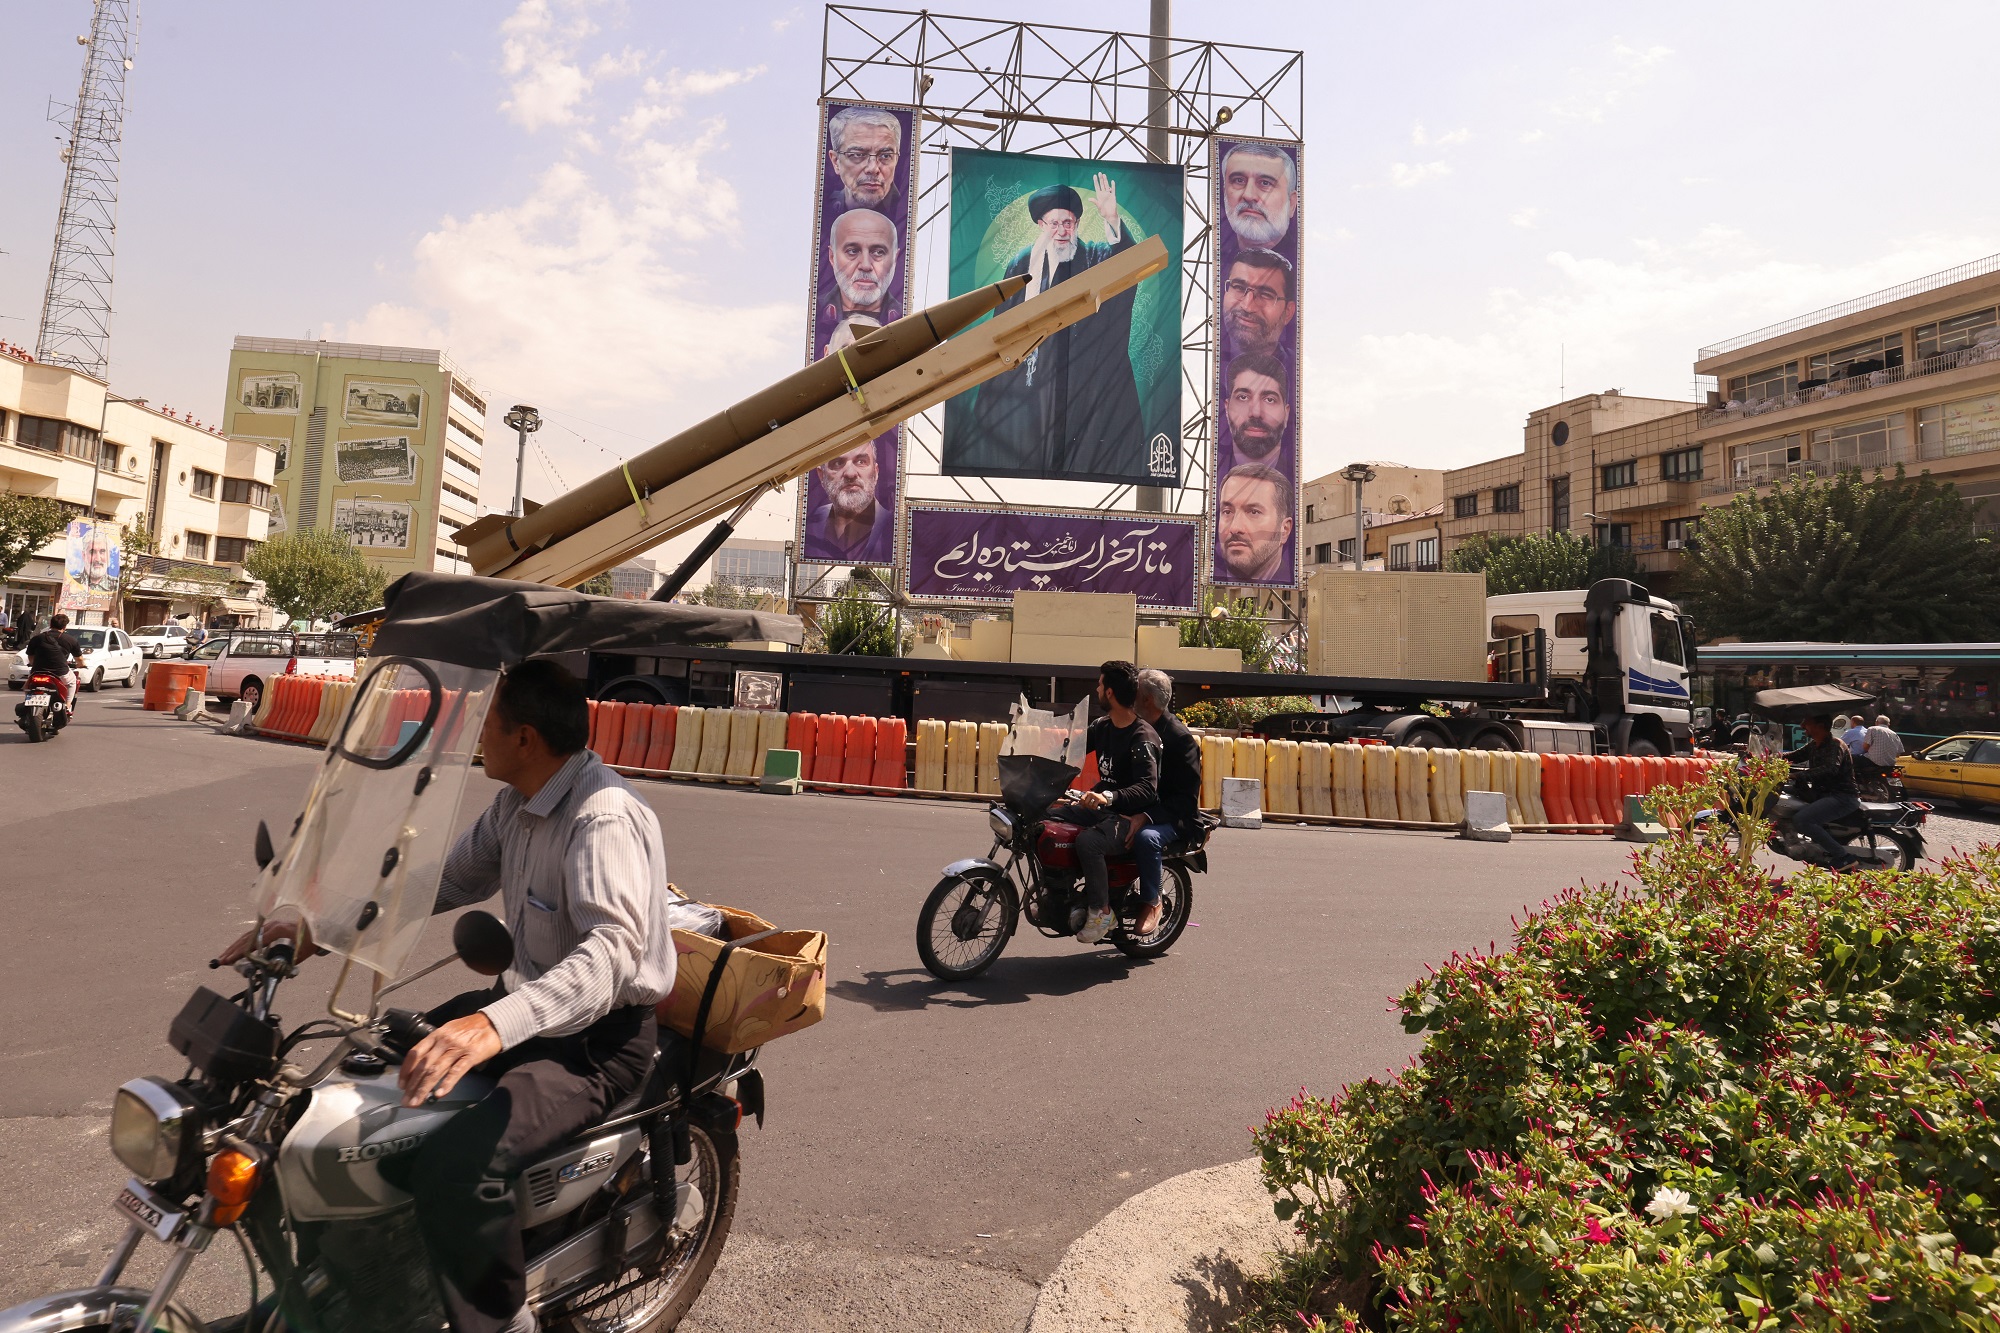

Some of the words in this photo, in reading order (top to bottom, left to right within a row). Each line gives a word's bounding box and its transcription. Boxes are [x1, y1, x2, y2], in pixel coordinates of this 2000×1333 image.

[1082, 524, 1159, 583] آخر
[1145, 541, 1168, 574] تا
[1159, 554, 1172, 575] ما
[946, 582, 979, 593] Imam
[982, 582, 1018, 594] Khom
